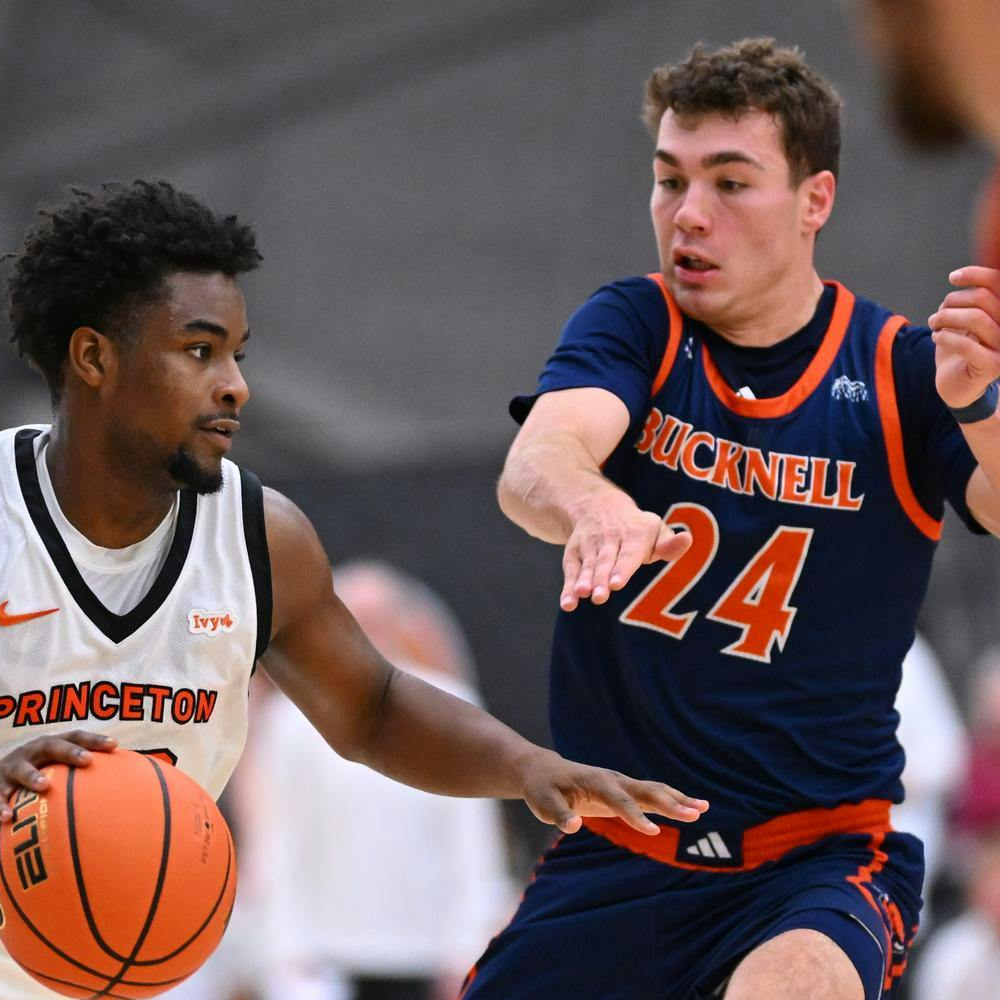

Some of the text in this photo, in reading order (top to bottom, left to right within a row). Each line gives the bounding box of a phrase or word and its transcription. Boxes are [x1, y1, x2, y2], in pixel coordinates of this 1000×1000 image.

[633, 406, 865, 511] BUCKNELL
[193, 614, 220, 631] Ivy
[619, 502, 814, 663] 24
